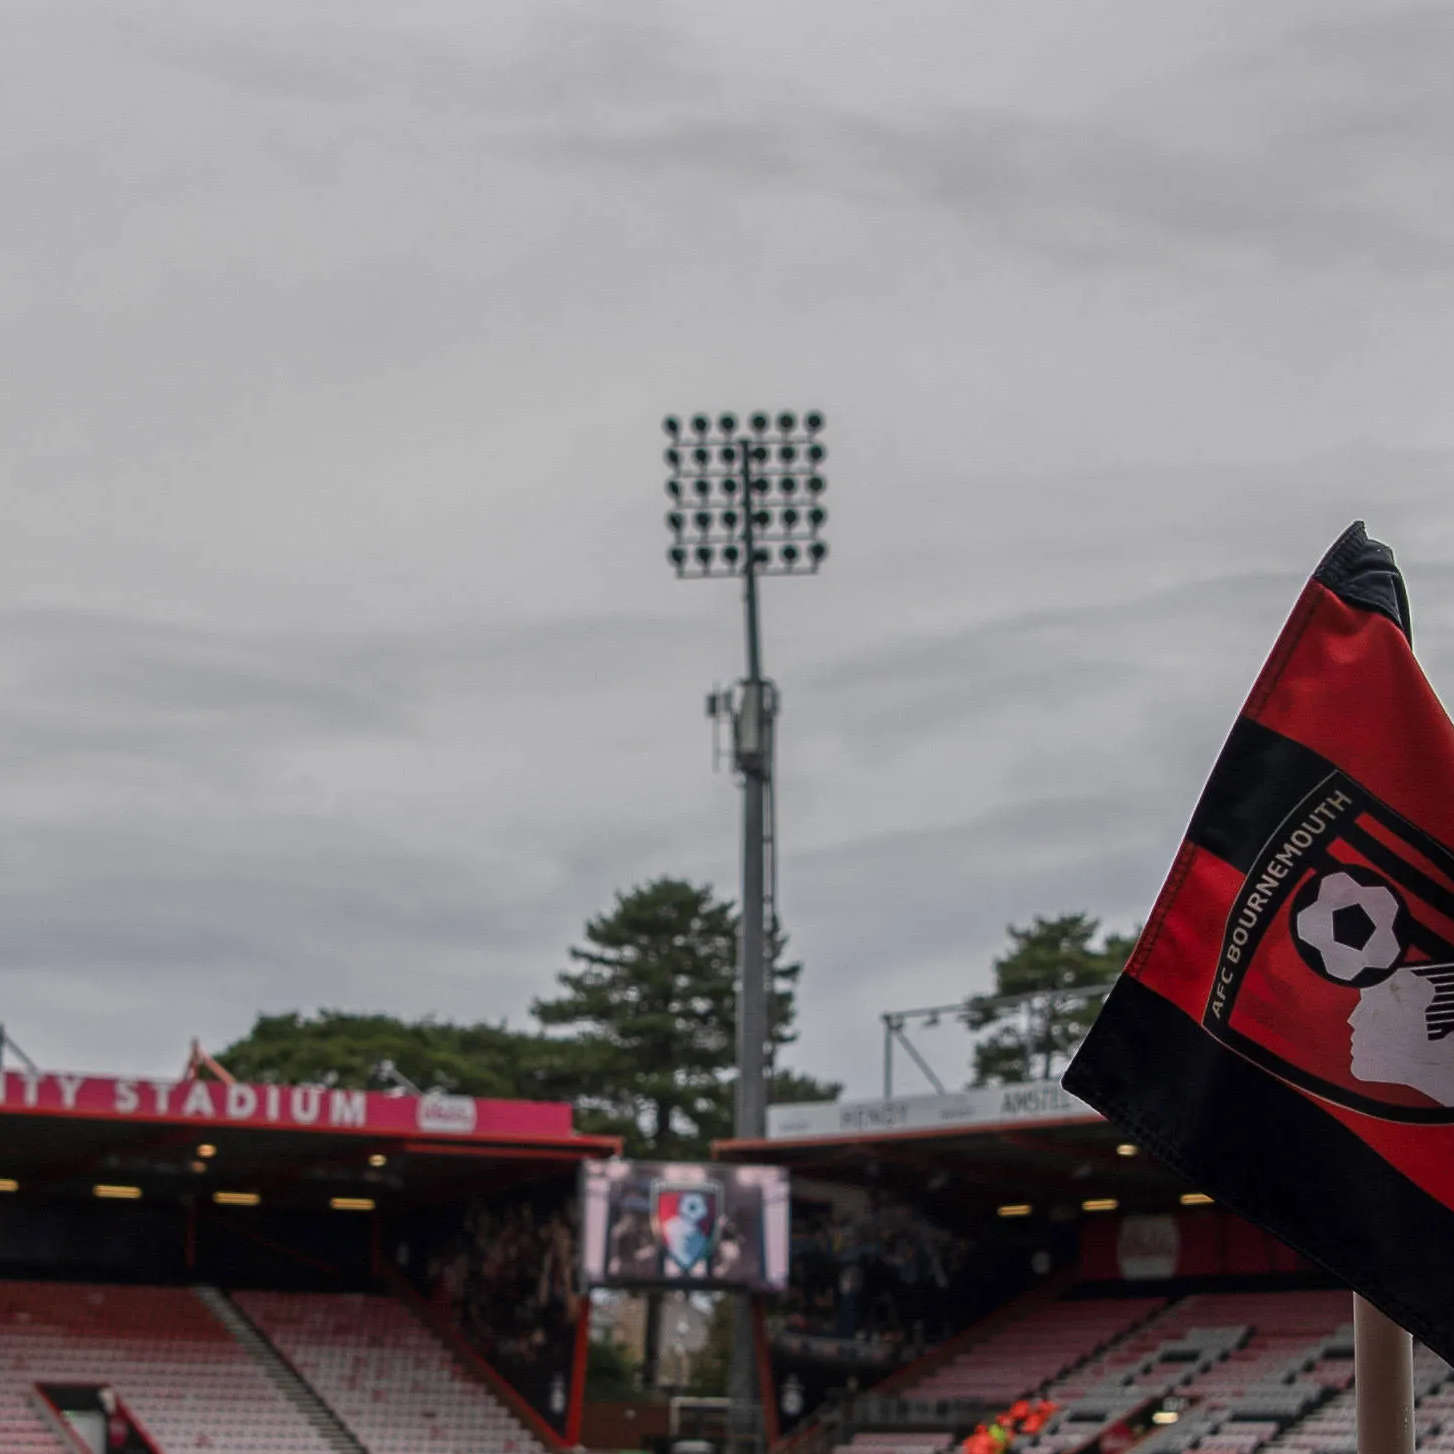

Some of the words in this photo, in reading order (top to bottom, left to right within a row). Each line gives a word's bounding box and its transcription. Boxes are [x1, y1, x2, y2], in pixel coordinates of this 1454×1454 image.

[1212, 968, 1234, 1019] AFC
[1226, 790, 1353, 964] BOURNEMOUTH
[113, 1078, 366, 1128] STADIUM
